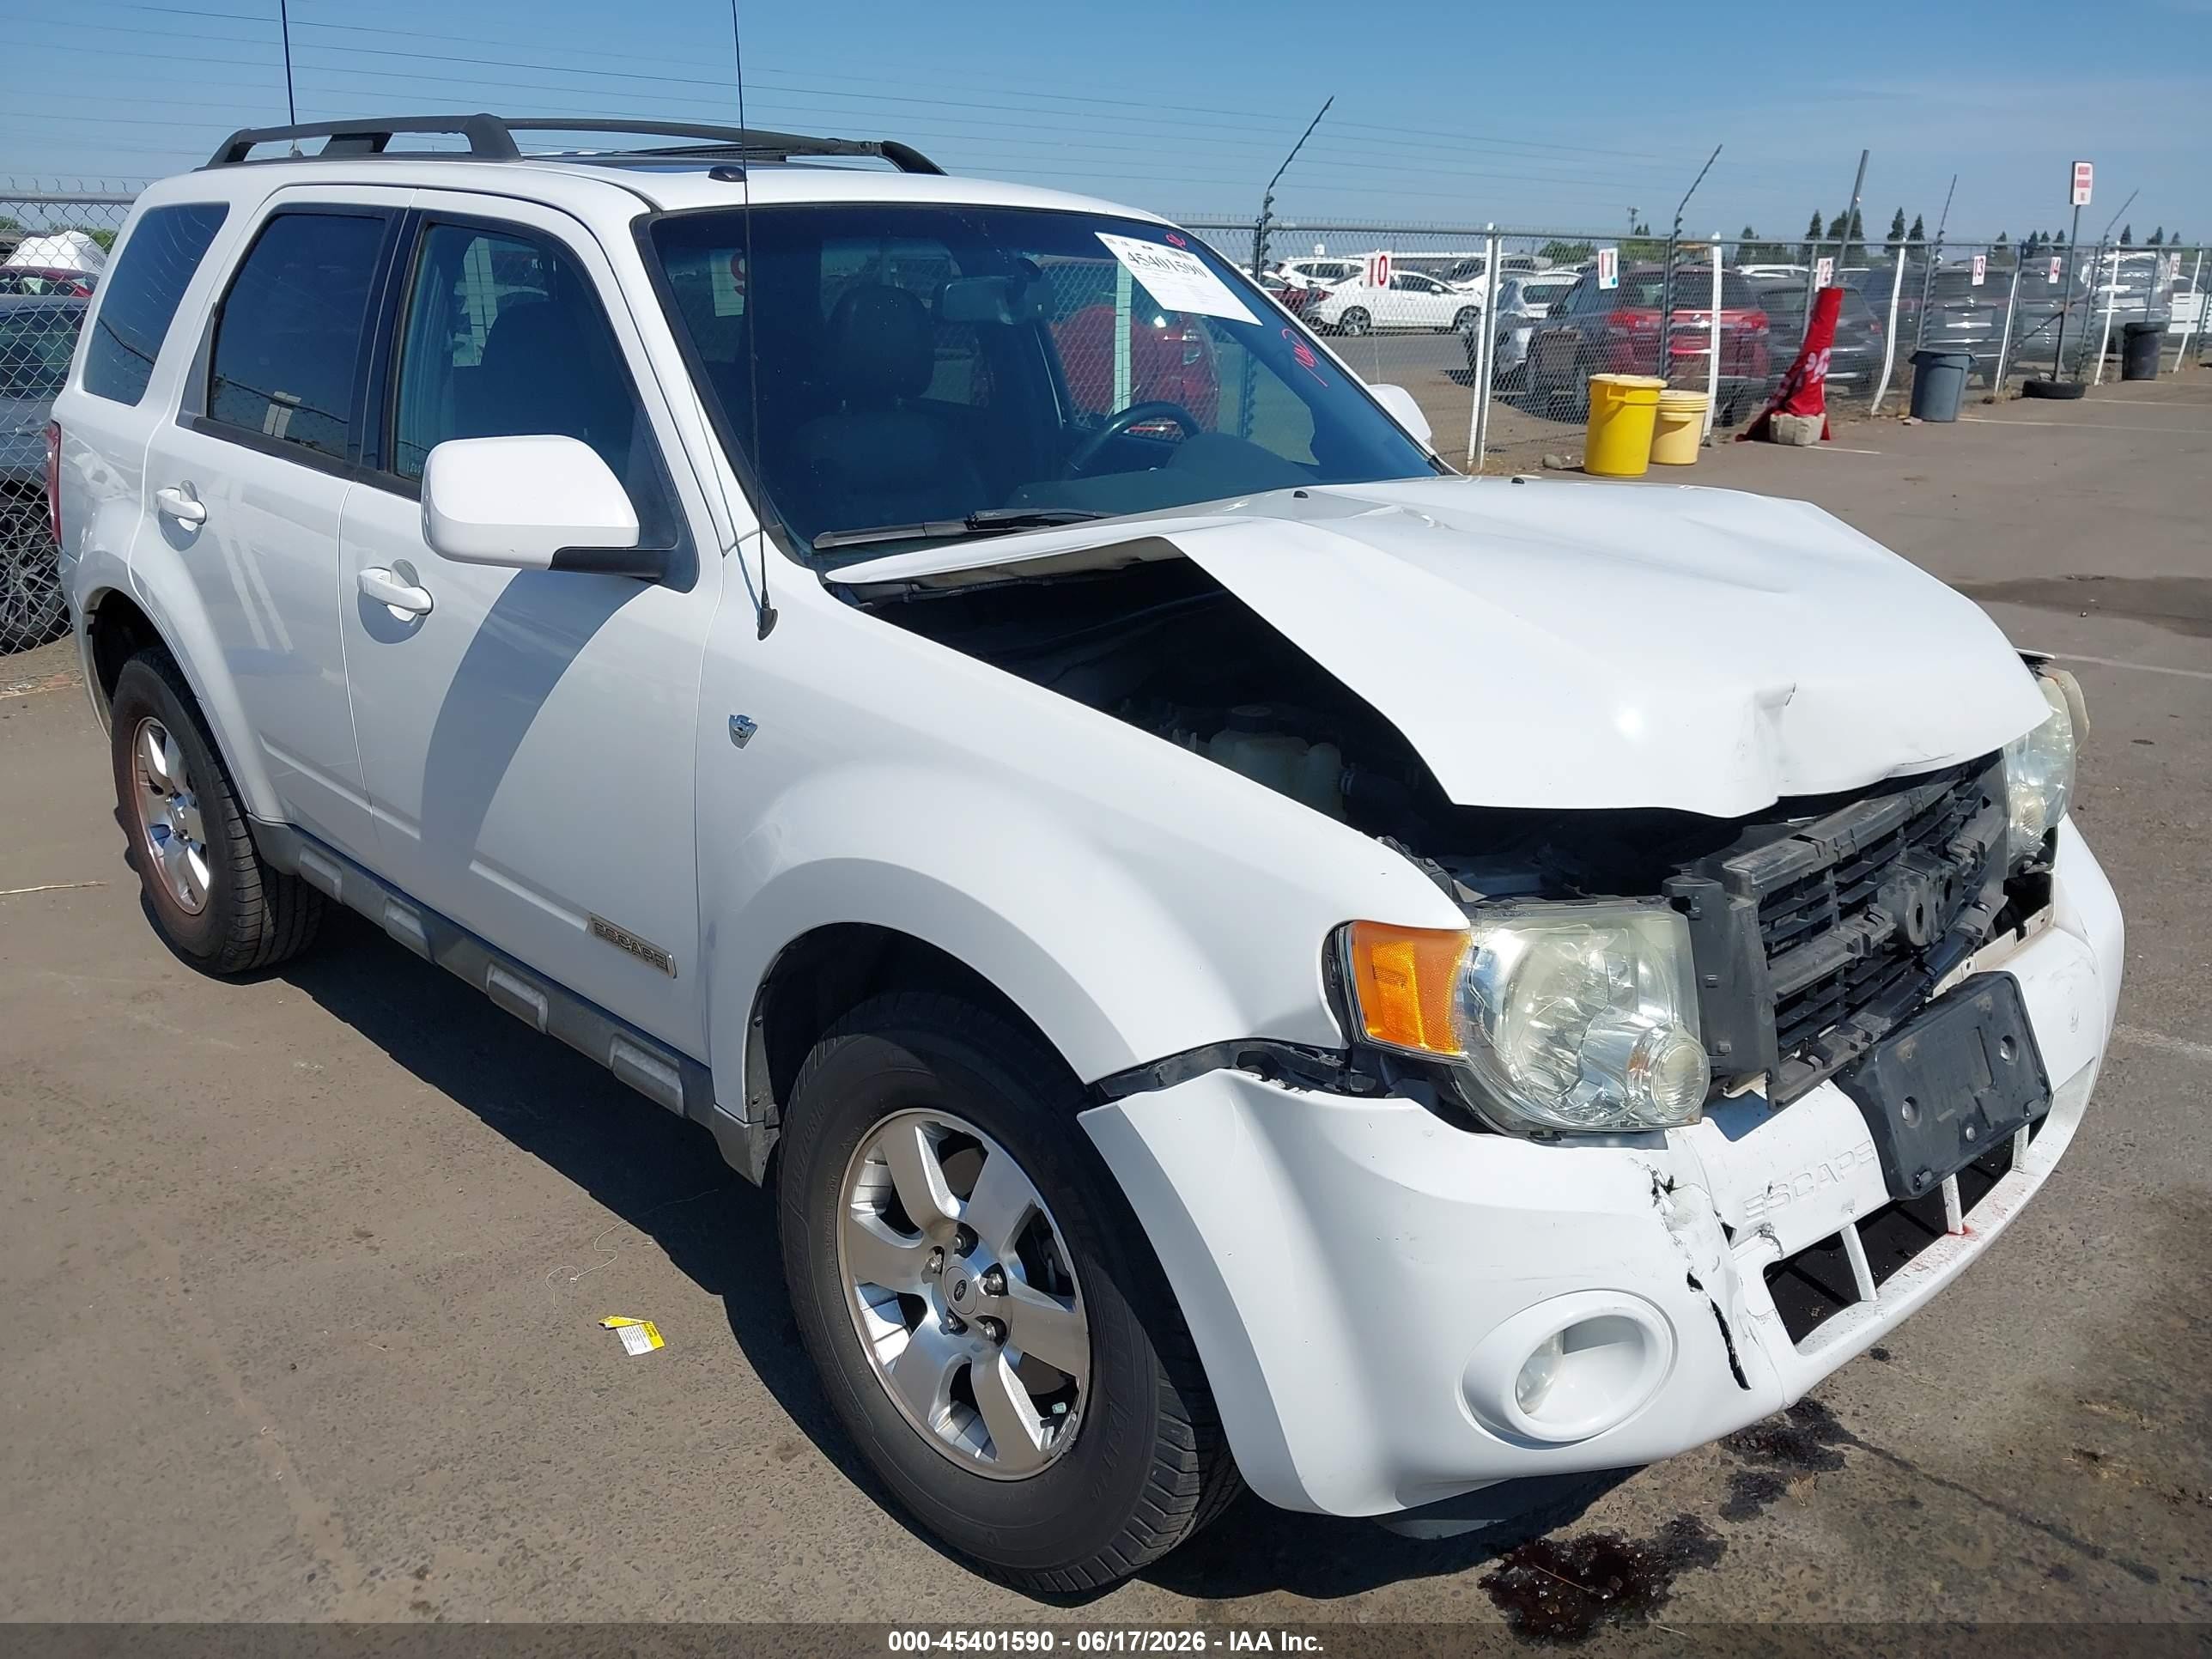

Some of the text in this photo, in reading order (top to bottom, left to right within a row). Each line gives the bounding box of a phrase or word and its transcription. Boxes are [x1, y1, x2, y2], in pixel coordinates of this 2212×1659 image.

[1127, 251, 1208, 278] 45401590
[1369, 254, 1388, 288] 10
[1601, 252, 1613, 278] 11
[1974, 257, 1984, 278] 13
[594, 920, 668, 969] ESCAPE
[1742, 1139, 1875, 1218] ESCAPE
